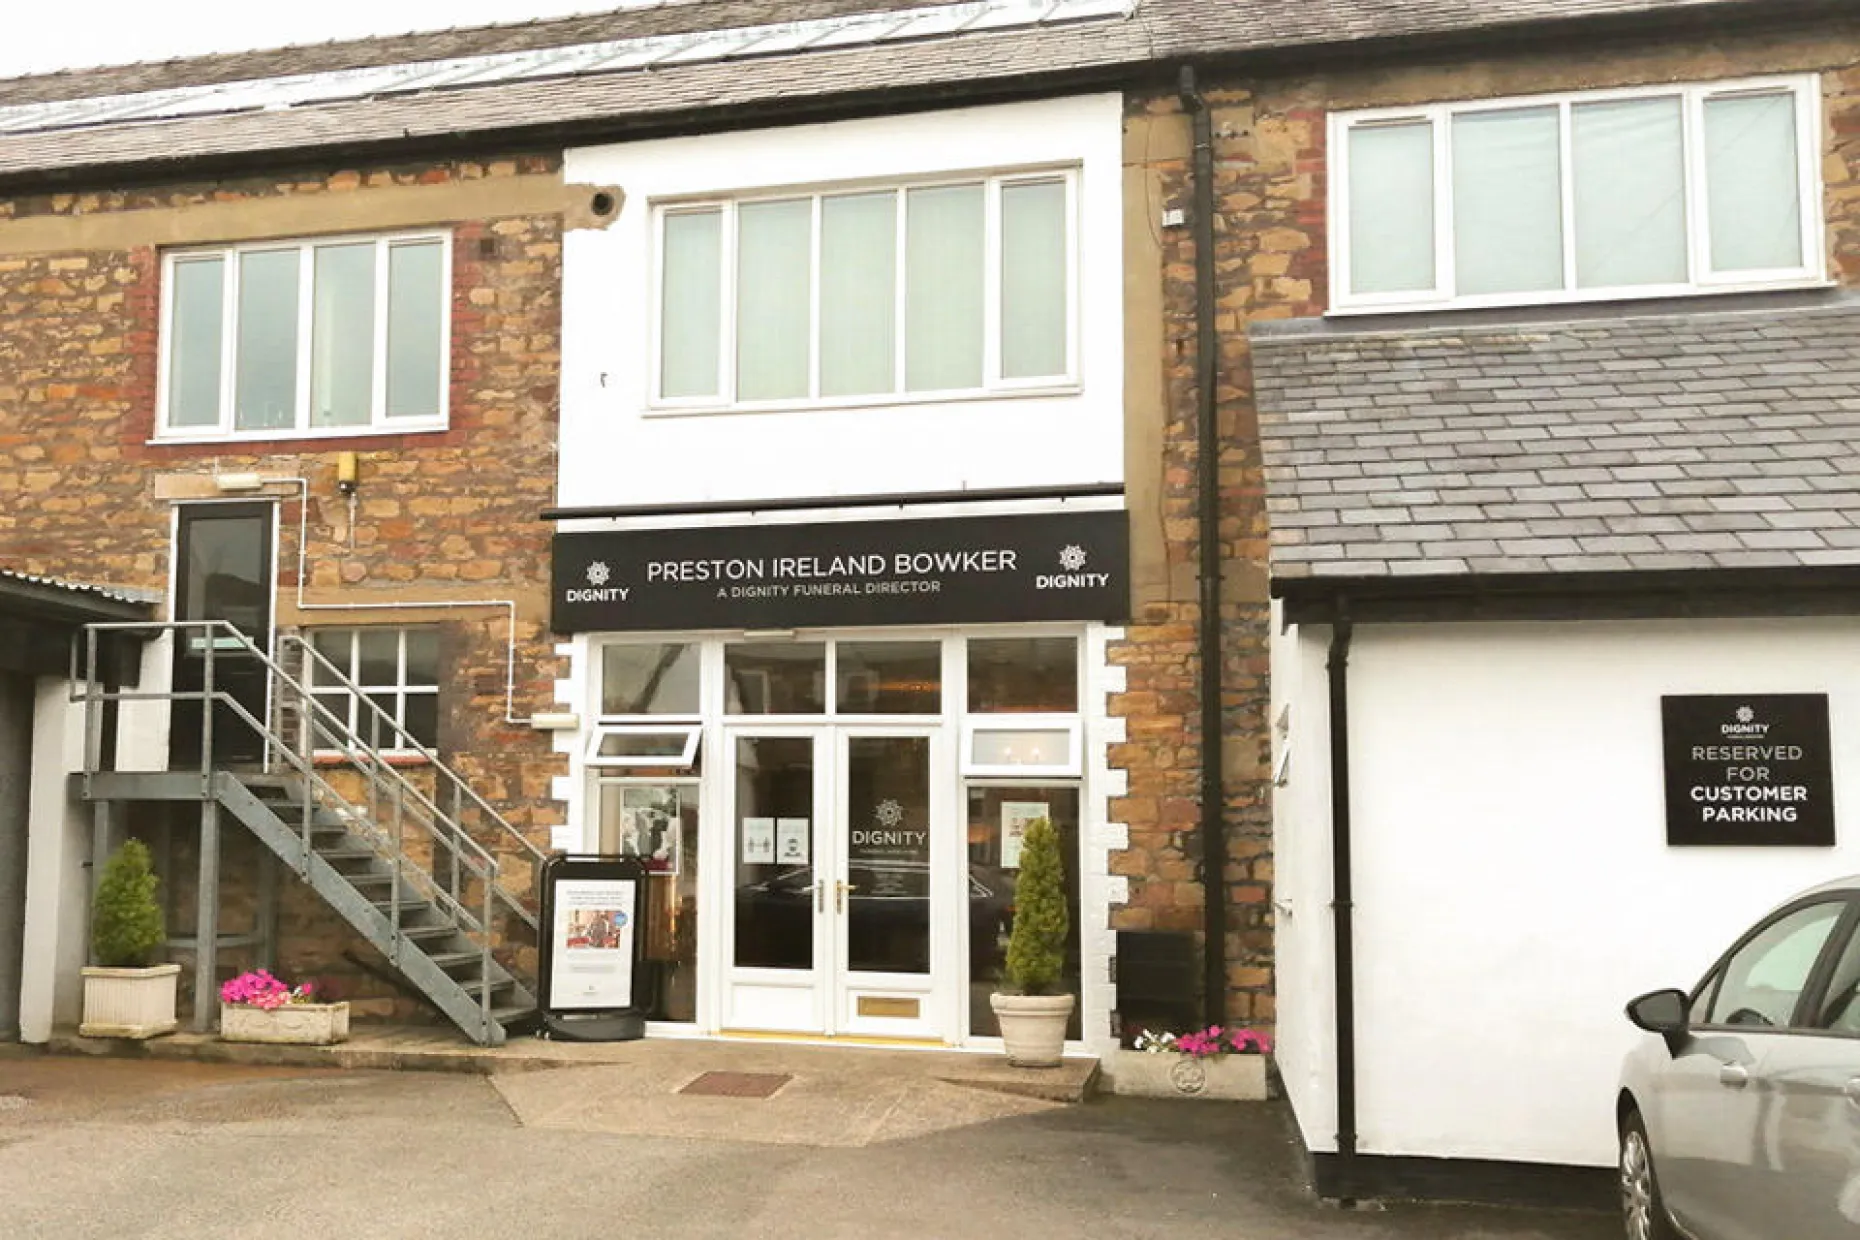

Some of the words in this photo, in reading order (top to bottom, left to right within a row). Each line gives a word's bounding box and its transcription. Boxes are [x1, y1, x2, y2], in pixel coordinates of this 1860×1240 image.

[647, 558, 764, 582] PRESTON
[772, 554, 887, 578] IRELAND
[894, 550, 1017, 575] BOWKER
[716, 586, 728, 598] A
[731, 585, 790, 598] DIGNITY
[794, 582, 861, 596] FUNERAL
[865, 580, 941, 594] DIRECTOR
[1035, 573, 1110, 589] DIGNITY
[566, 587, 630, 602] DIGNITY
[1721, 724, 1770, 734] DIGNITY
[1692, 745, 1803, 761] RESERVED
[1726, 766, 1770, 781] FOR
[1690, 785, 1809, 801] CUSTOMER
[1702, 806, 1798, 822] PARKING
[852, 830, 927, 845] DIGNITY
